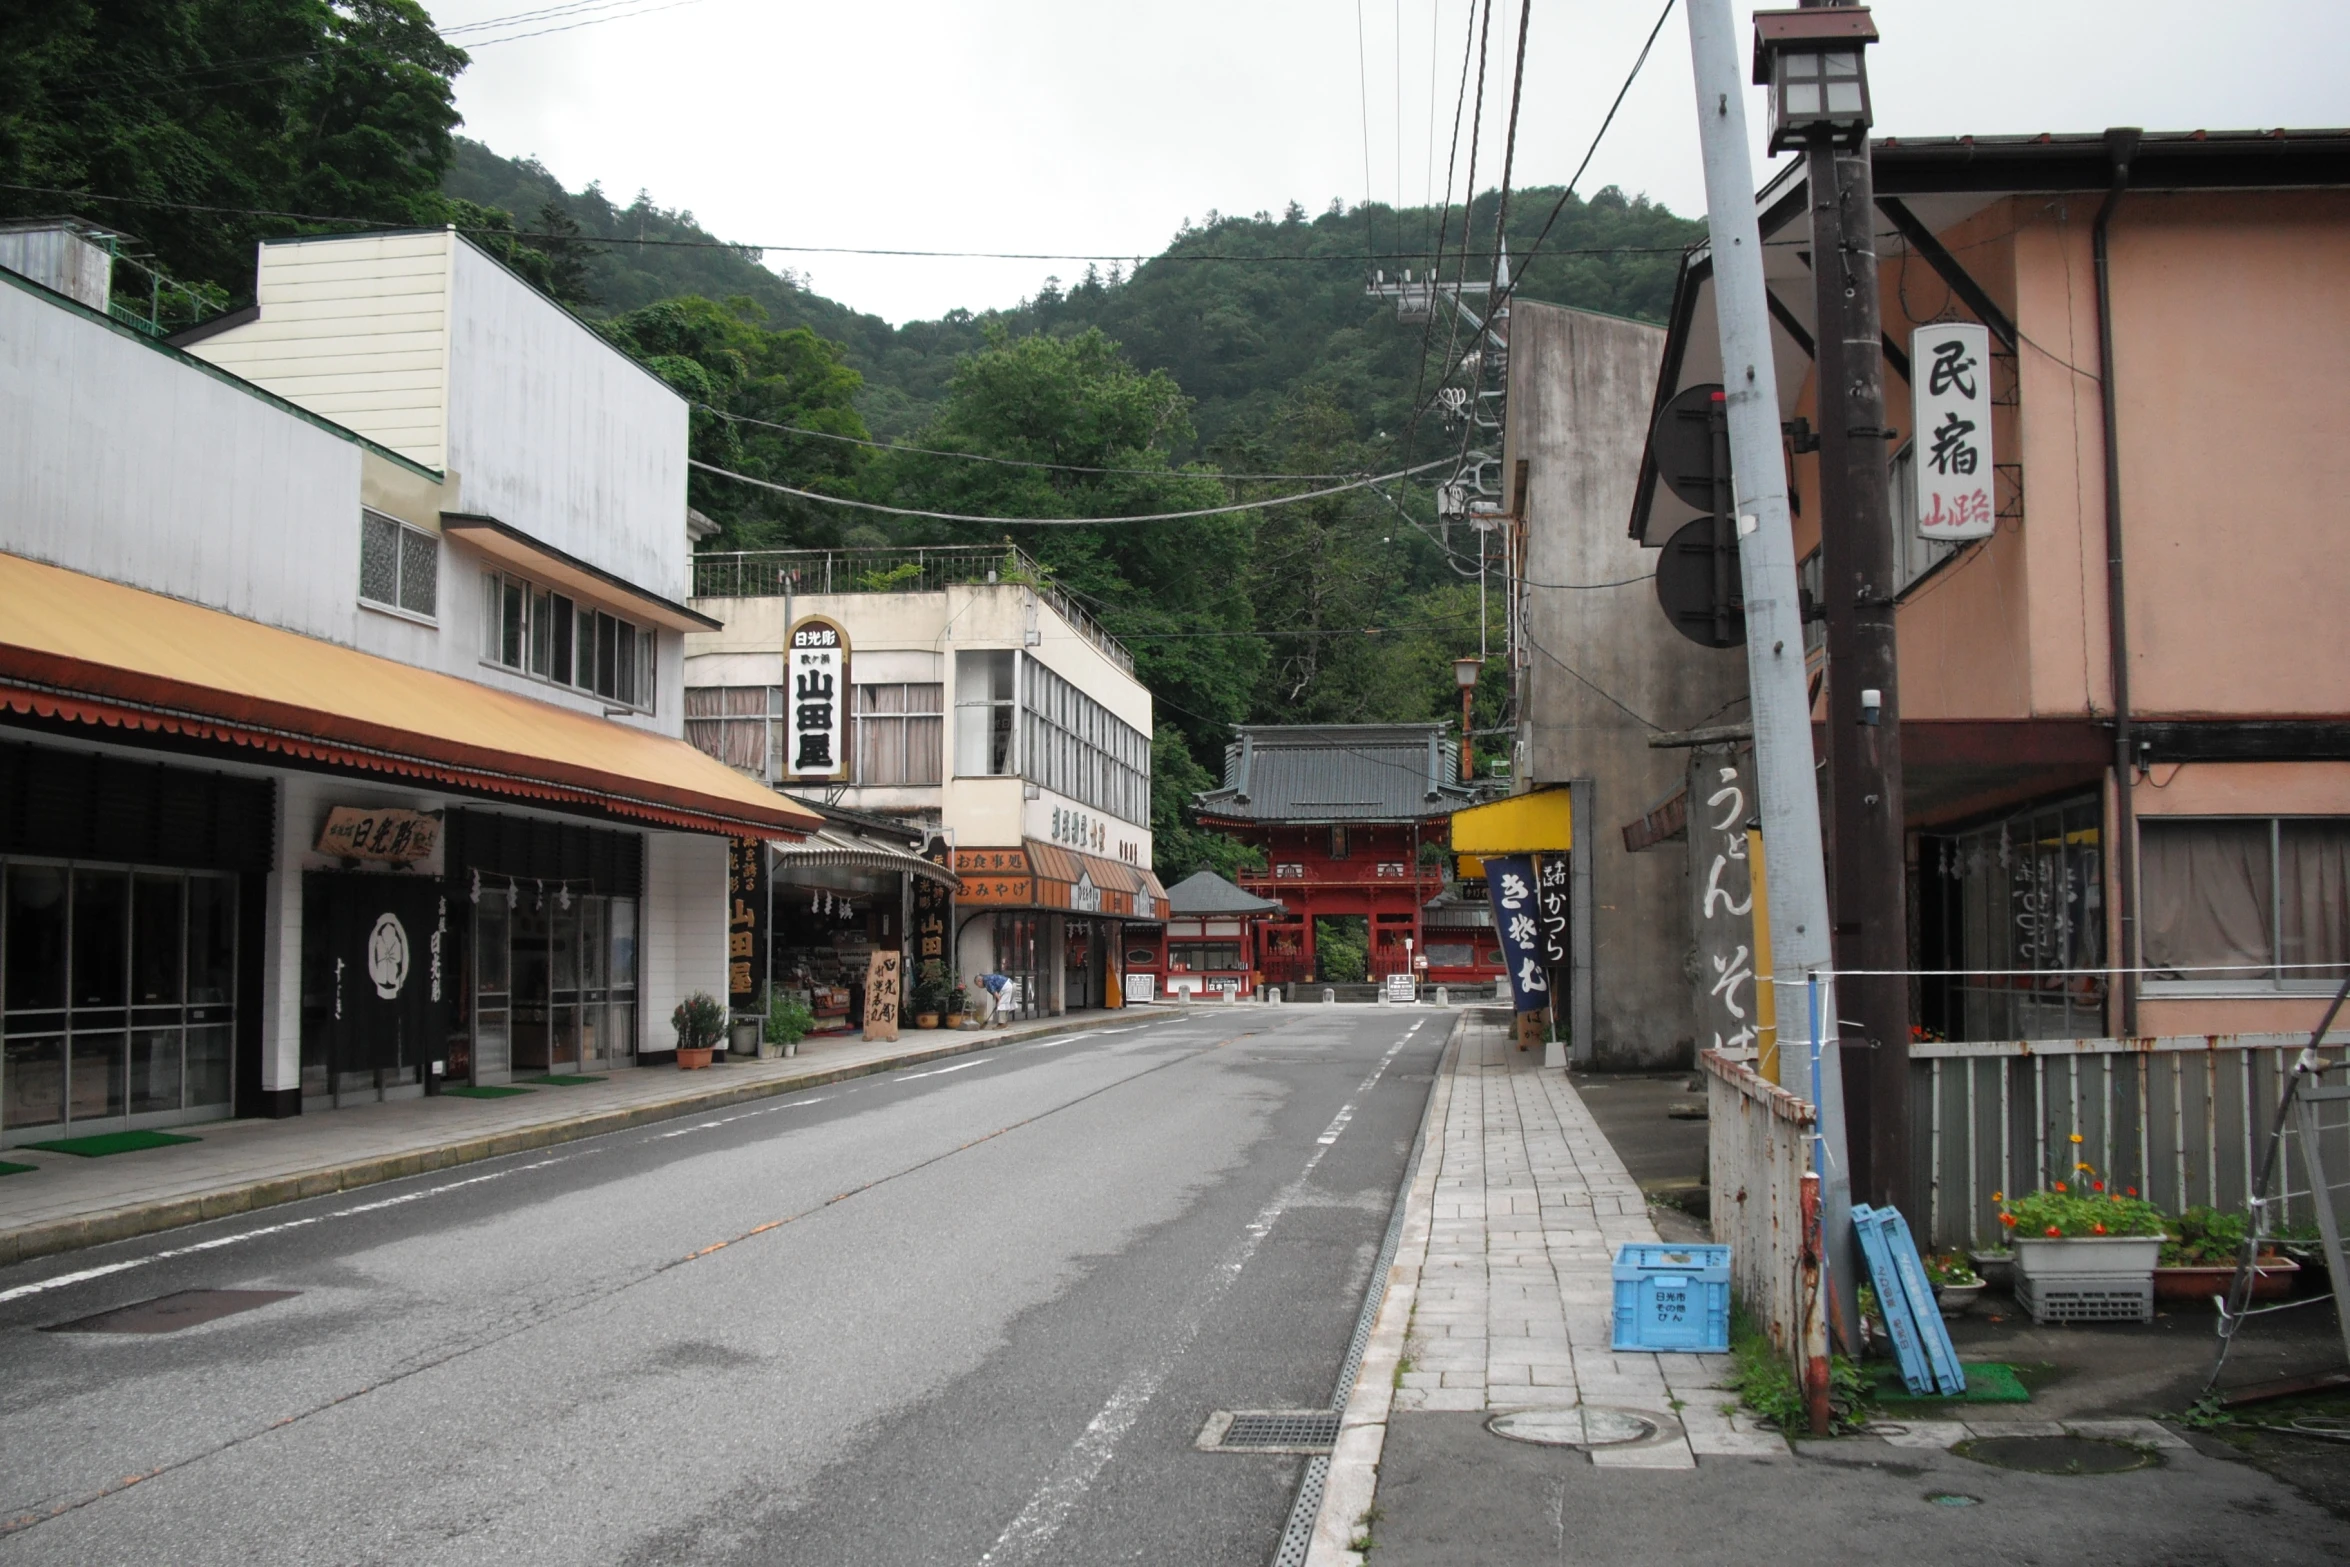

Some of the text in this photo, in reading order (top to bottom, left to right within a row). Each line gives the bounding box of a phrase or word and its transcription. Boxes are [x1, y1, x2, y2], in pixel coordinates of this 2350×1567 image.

[1927, 340, 1978, 476] 民宿
[1922, 487, 1991, 527] 山路
[794, 630, 836, 647] 日光彫
[795, 669, 834, 770] 山田屋
[352, 816, 417, 855] 日光彫
[1704, 767, 1752, 919] うどん
[956, 854, 1022, 869] お食事処
[1554, 860, 1567, 886] 手打
[956, 880, 1030, 897] おみやげ
[1543, 893, 1567, 961] かつら
[730, 898, 755, 994] 山田屋
[1655, 1291, 1686, 1302] 日光市
[1655, 1303, 1686, 1314] その他
[1657, 1313, 1683, 1323] びん
[1893, 1317, 1910, 1351] 日光市
